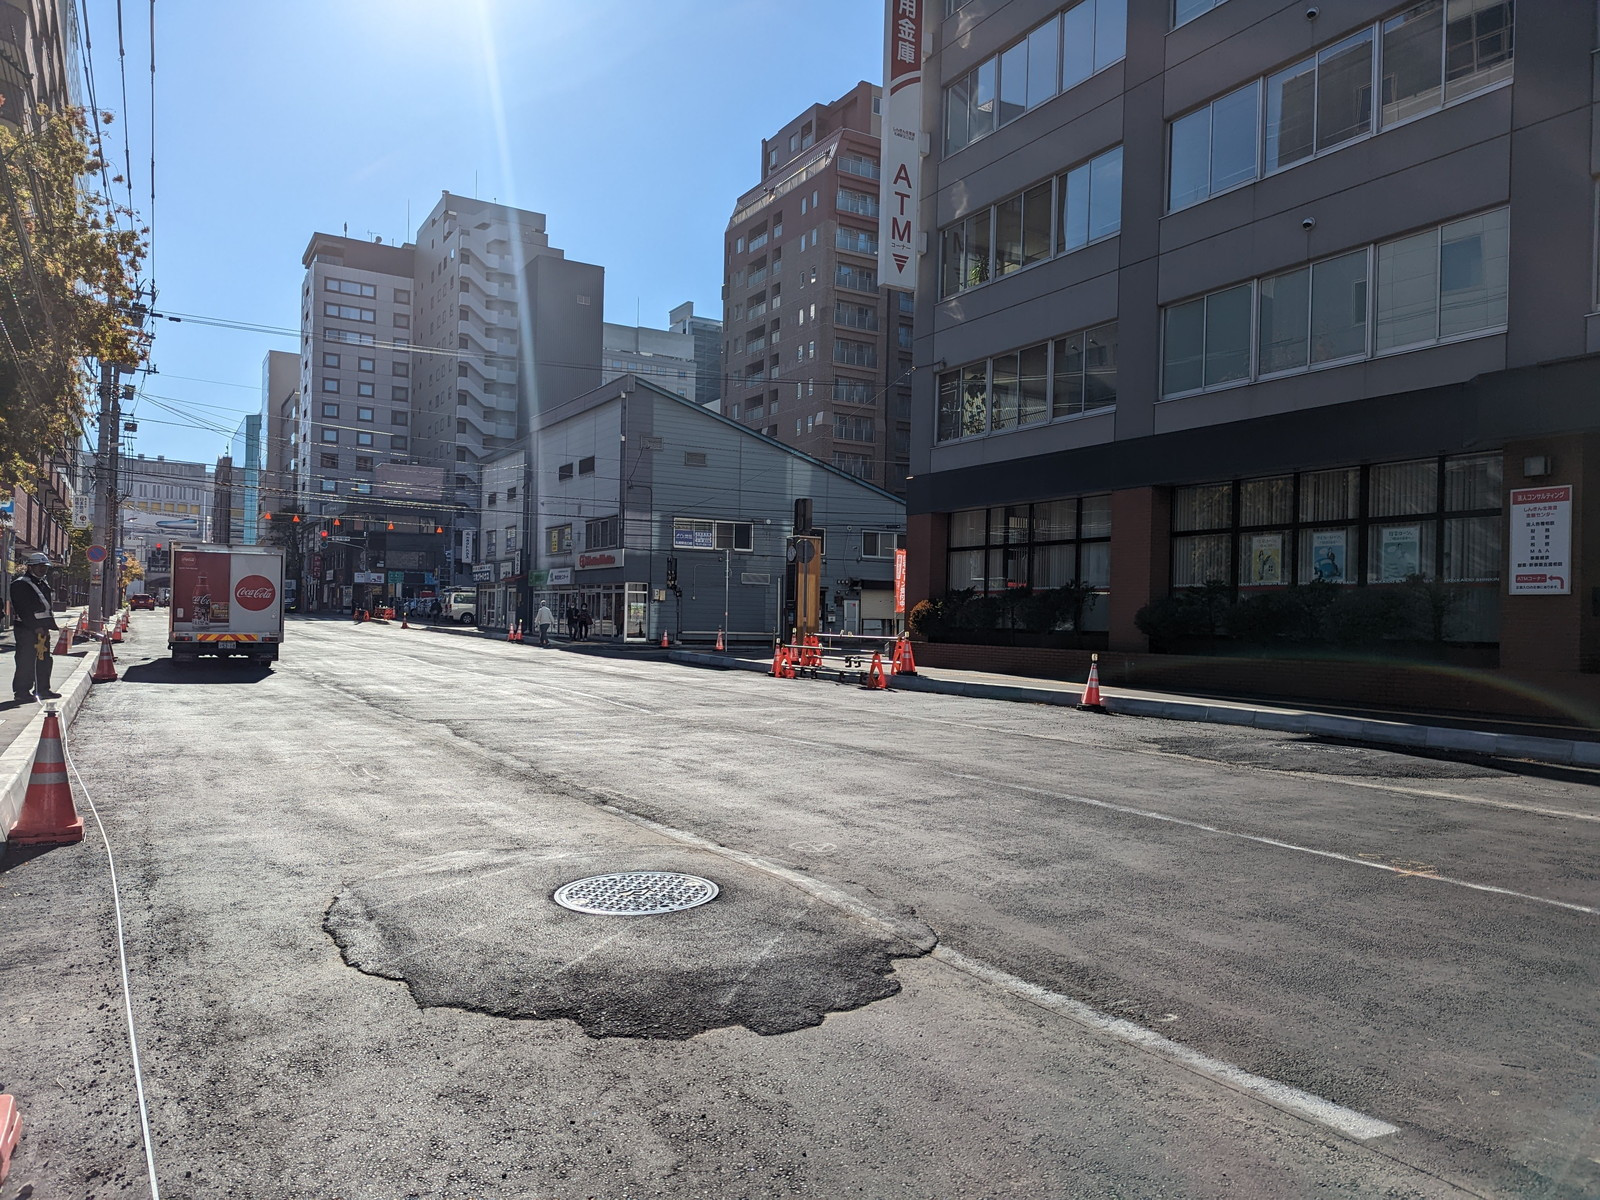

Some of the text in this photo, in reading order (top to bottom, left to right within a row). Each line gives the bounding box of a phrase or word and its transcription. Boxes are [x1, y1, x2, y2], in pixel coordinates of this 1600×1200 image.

[891, 163, 912, 243] ATM
[891, 242, 911, 250] コーナー
